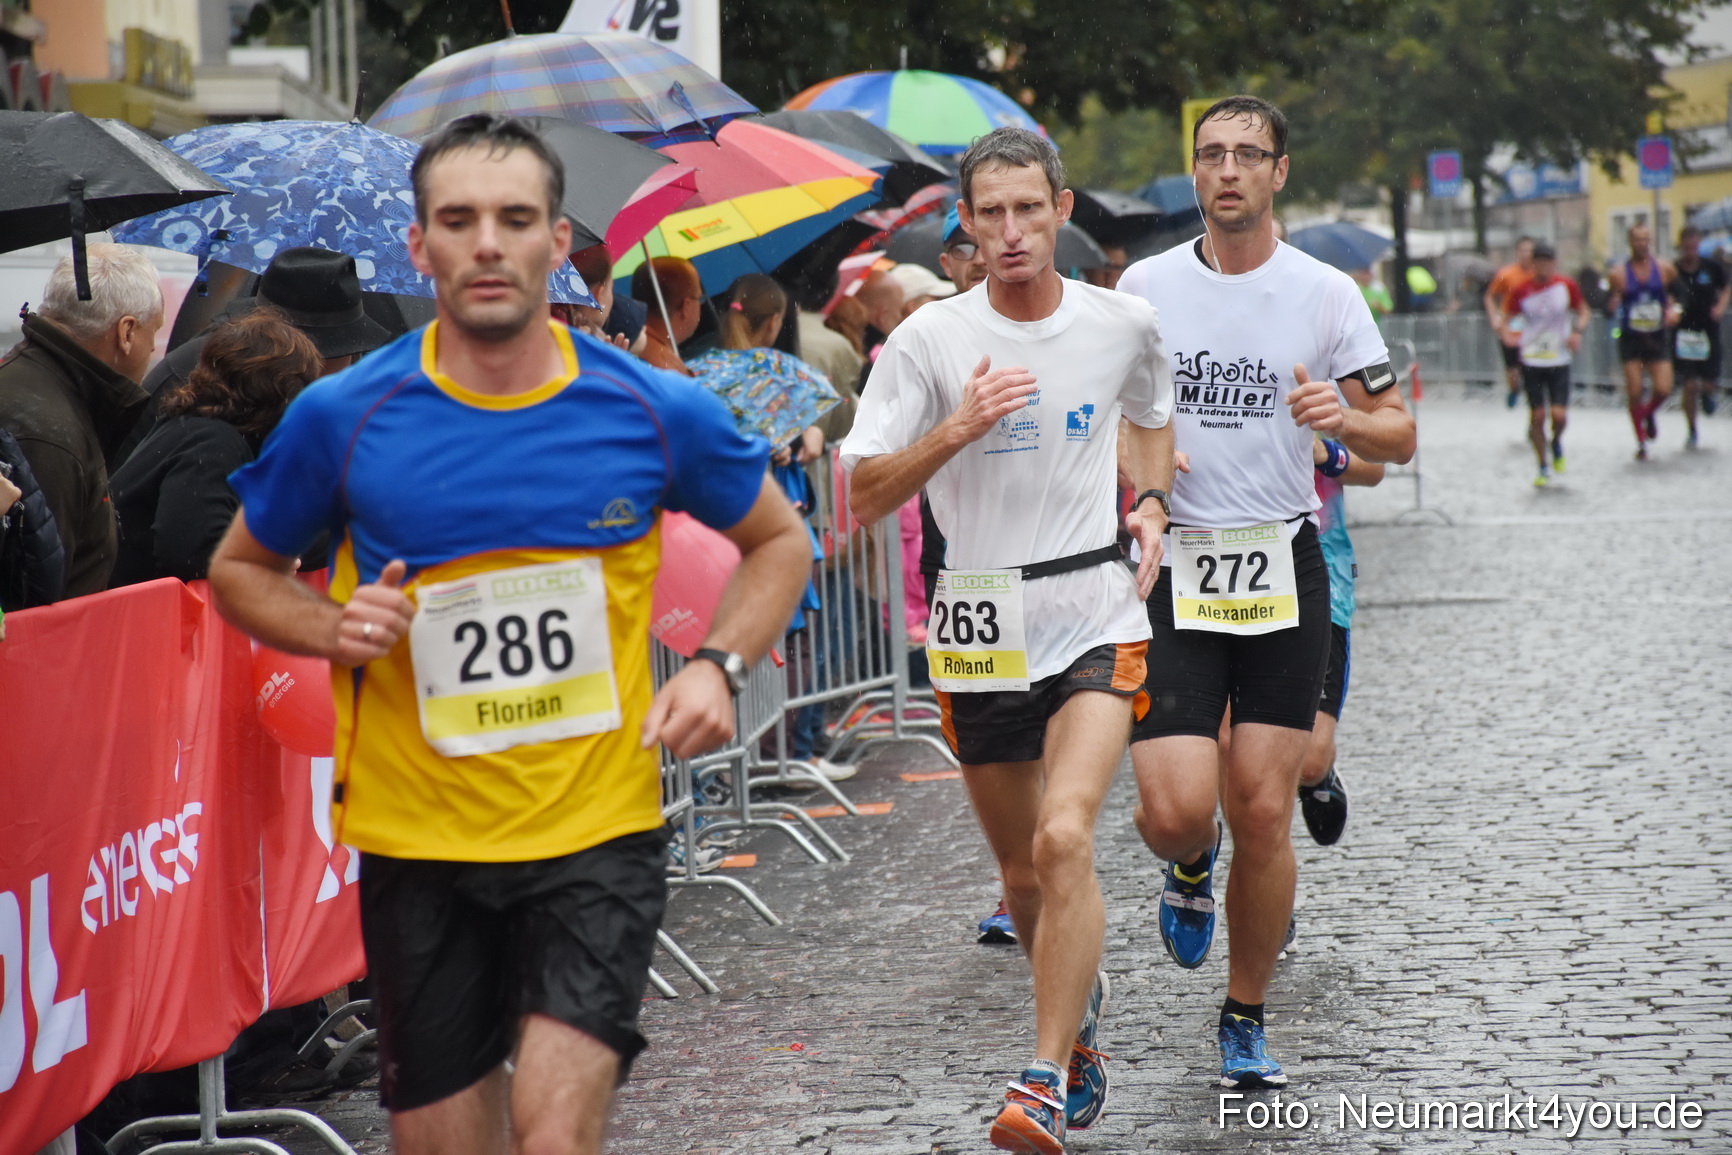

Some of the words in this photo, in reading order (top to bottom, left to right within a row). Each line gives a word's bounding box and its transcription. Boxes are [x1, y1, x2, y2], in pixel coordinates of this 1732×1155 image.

[1174, 350, 1279, 389] Sport
[1180, 384, 1272, 407] Müller
[1176, 406, 1193, 415] Inh.
[1196, 407, 1239, 417] Andreas
[1242, 410, 1274, 418] Winter
[1067, 428, 1087, 436] DKMS
[1200, 420, 1243, 429] Neumarkt
[1222, 526, 1279, 543] BOCK
[1197, 551, 1270, 594] 272
[952, 575, 1010, 590] BOCK
[1197, 603, 1275, 621] Alexander
[935, 600, 1000, 645] 263
[454, 609, 574, 684] 286
[944, 656, 994, 675] Roland
[476, 695, 562, 727] Florian
